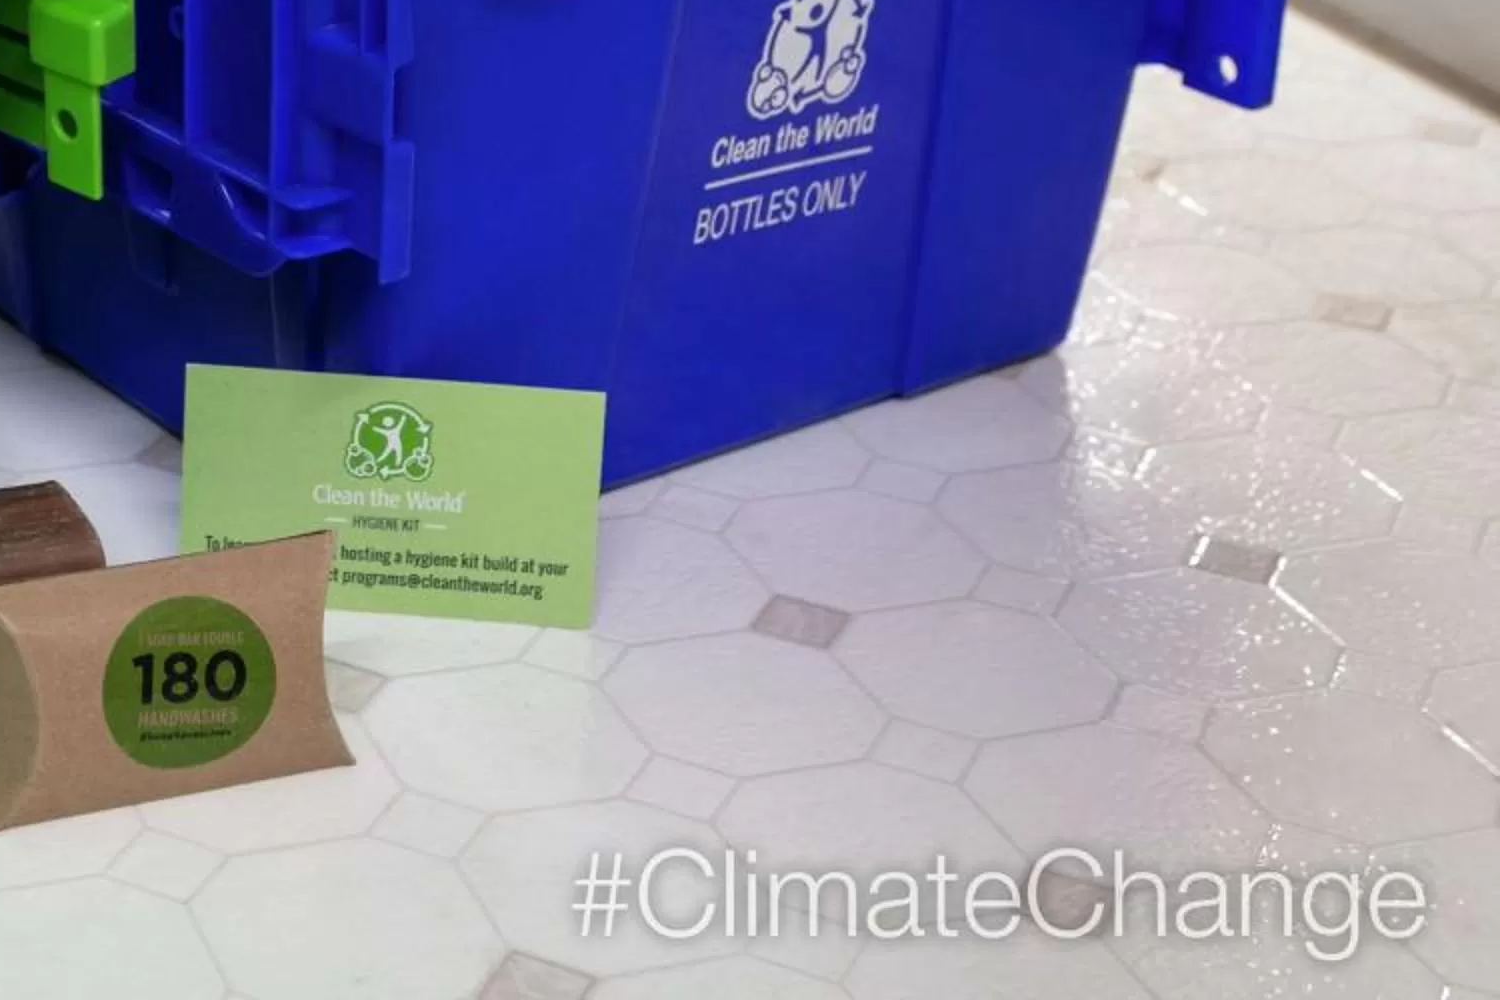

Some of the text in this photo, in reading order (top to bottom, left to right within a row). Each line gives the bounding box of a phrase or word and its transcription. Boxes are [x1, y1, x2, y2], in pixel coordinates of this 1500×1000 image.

[711, 104, 879, 168] Clean the World
[693, 170, 866, 245] BOTTLES ONLY
[312, 483, 463, 513] Clean the World
[352, 516, 421, 533] HYGIENE KIT
[204, 535, 220, 552] To
[341, 544, 569, 577] hosting a hygiene kit build at your
[343, 570, 543, 600] programs@cleantheworld.org
[131, 649, 247, 705] 180
